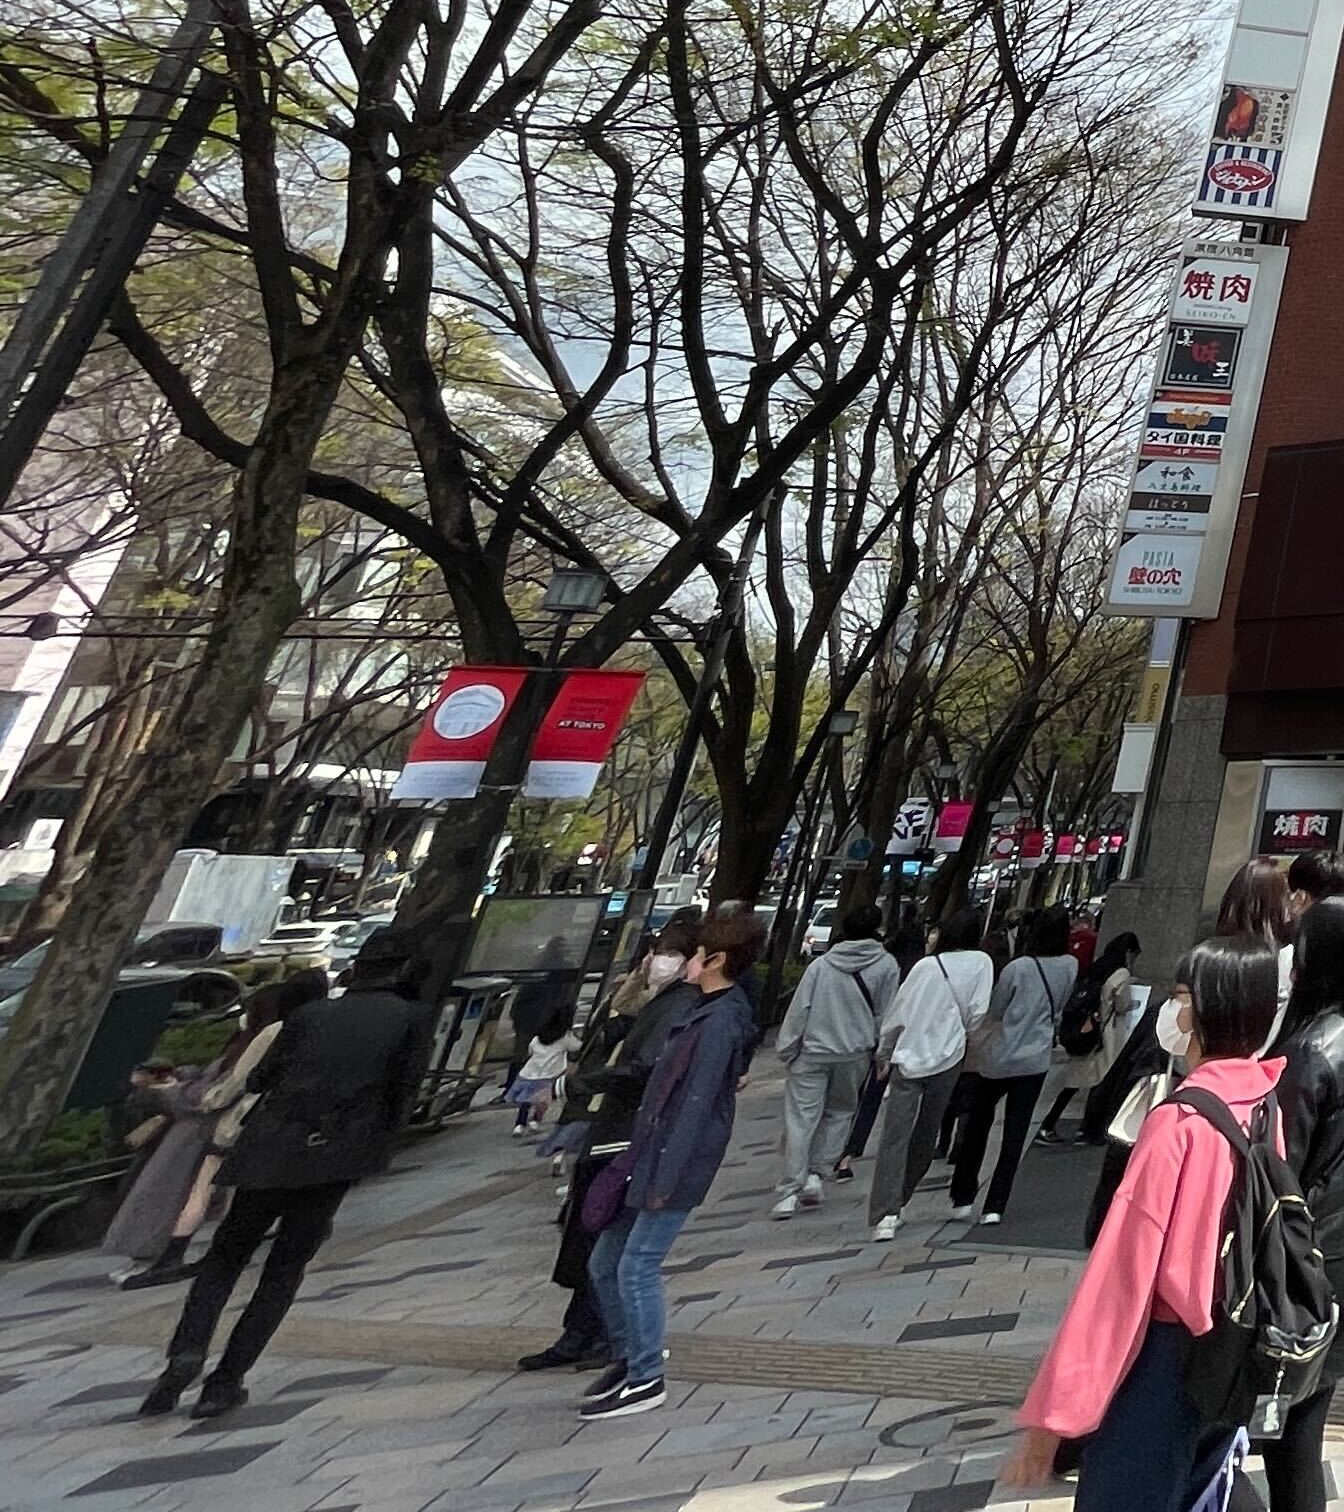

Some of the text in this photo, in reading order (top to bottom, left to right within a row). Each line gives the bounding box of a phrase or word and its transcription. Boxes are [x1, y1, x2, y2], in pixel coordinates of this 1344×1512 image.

[1179, 269, 1252, 303] 焼肉
[1147, 431, 1221, 446] タイ国料理
[1160, 466, 1195, 481] 和食
[1142, 551, 1175, 566] PASTA
[1128, 567, 1181, 585] 壁の穴
[1273, 814, 1330, 837] 焼肉
